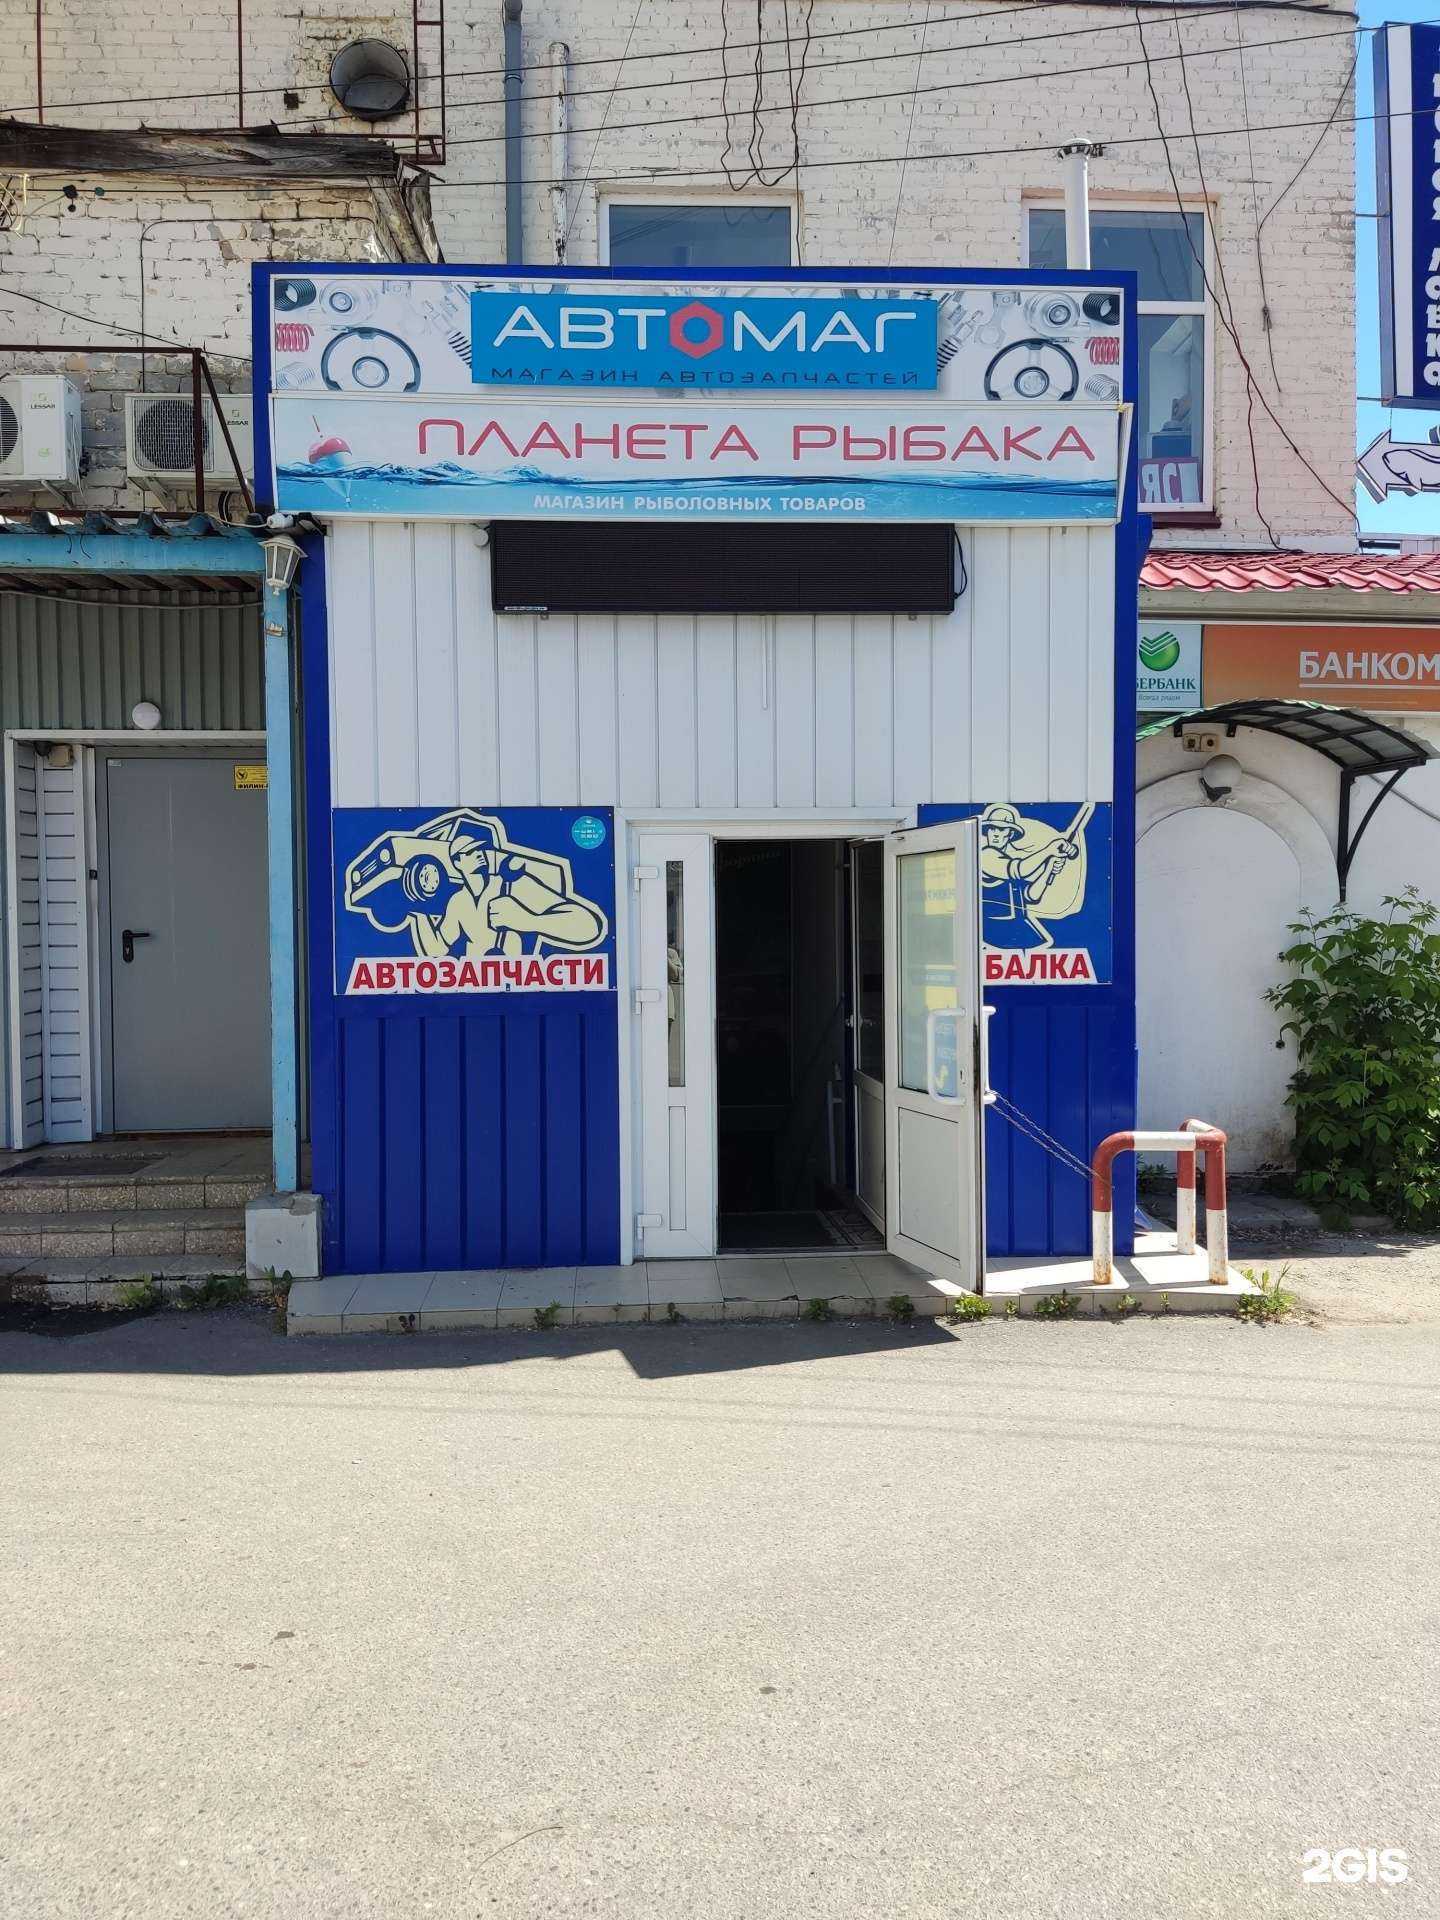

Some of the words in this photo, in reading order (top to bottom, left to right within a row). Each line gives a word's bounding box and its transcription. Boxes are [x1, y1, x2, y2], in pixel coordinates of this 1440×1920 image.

[493, 301, 917, 359] АВТОМАГ
[491, 367, 638, 382] МАГАЗИН
[658, 371, 919, 385] АВТОЗАПЧАСТЕЙ
[418, 418, 759, 461] ПЛАНЕТА
[793, 425, 1096, 461] РЫБАКА
[534, 494, 624, 510] МАГАЗИН
[634, 496, 772, 512] РЫБОЛОВНЫХ
[779, 497, 867, 512] ТОВАРОВ
[352, 958, 604, 990] АВТОЗАПЧАСТИ
